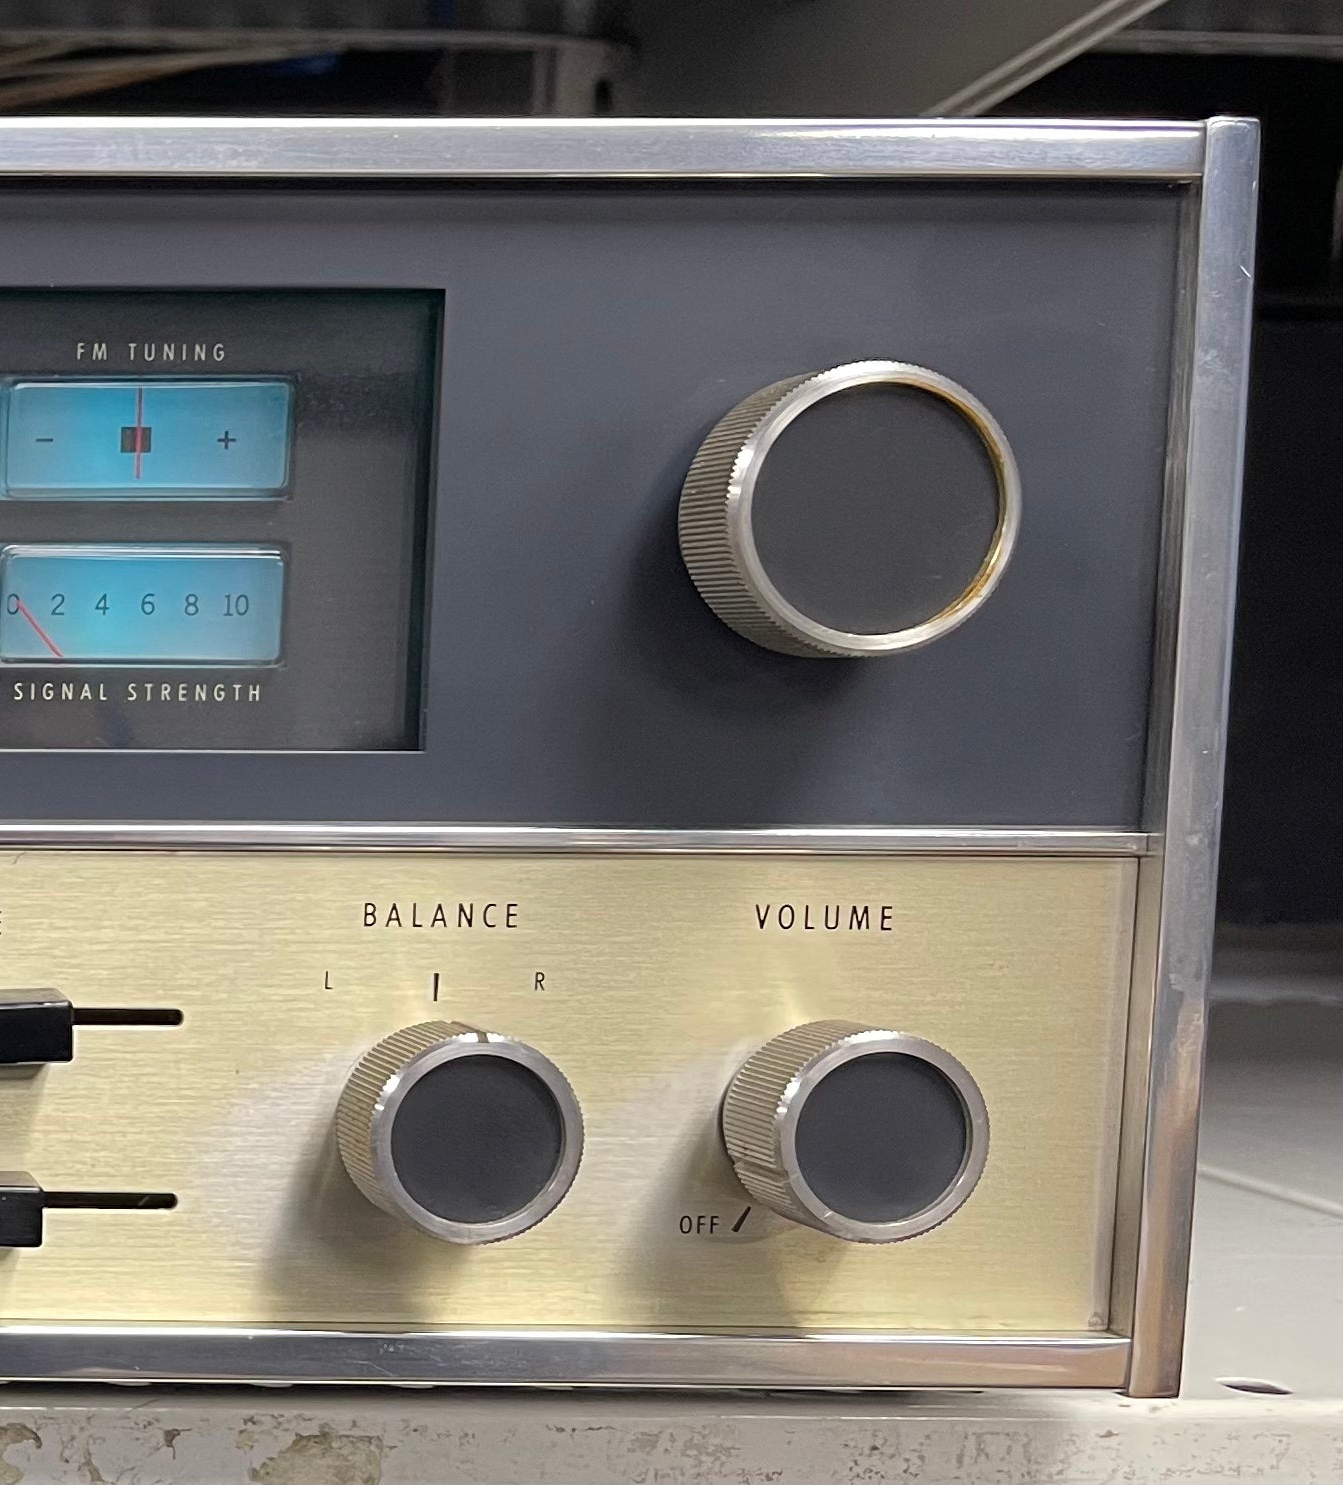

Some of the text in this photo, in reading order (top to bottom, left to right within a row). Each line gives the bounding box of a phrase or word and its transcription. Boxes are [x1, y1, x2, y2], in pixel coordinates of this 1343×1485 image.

[76, 342, 225, 362] FM TUNING
[6, 592, 250, 617] 0 2 4 6 8 10
[13, 682, 260, 702] SIGNAL STRENGTH
[363, 902, 518, 929] BALANCE
[755, 903, 893, 931] VOLUME
[324, 970, 332, 990] L
[534, 971, 545, 991] R
[679, 1215, 719, 1235] OFF
